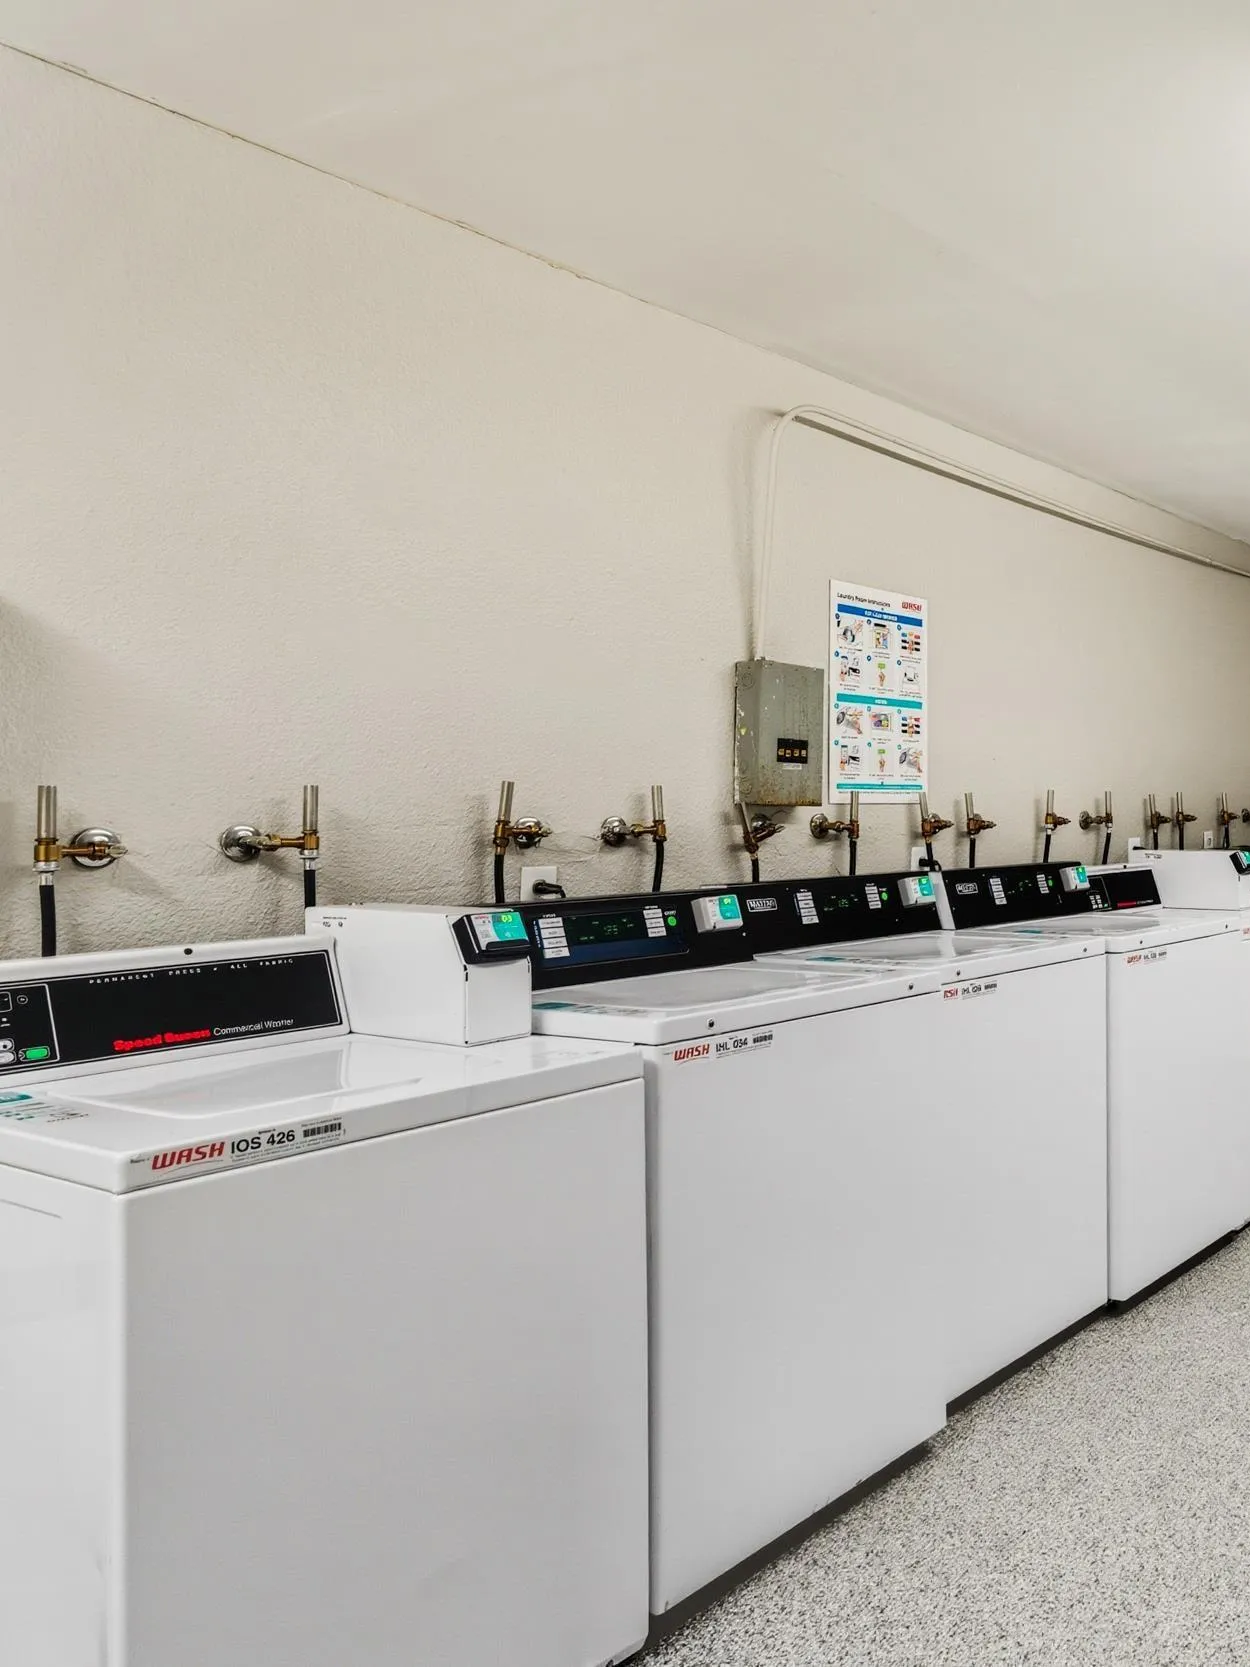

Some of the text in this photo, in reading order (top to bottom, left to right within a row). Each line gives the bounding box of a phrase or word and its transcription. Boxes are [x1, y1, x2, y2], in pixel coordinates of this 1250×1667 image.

[89, 973, 154, 984] PERMANENT
[168, 967, 201, 975] PRESS
[260, 958, 294, 966] FABRIC
[113, 1033, 163, 1052] Speed
[213, 1022, 264, 1037] Commercial
[674, 1043, 710, 1062] WASH
[151, 1141, 226, 1171] WASH
[230, 1136, 262, 1155] IOS
[266, 1129, 296, 1147] 426
